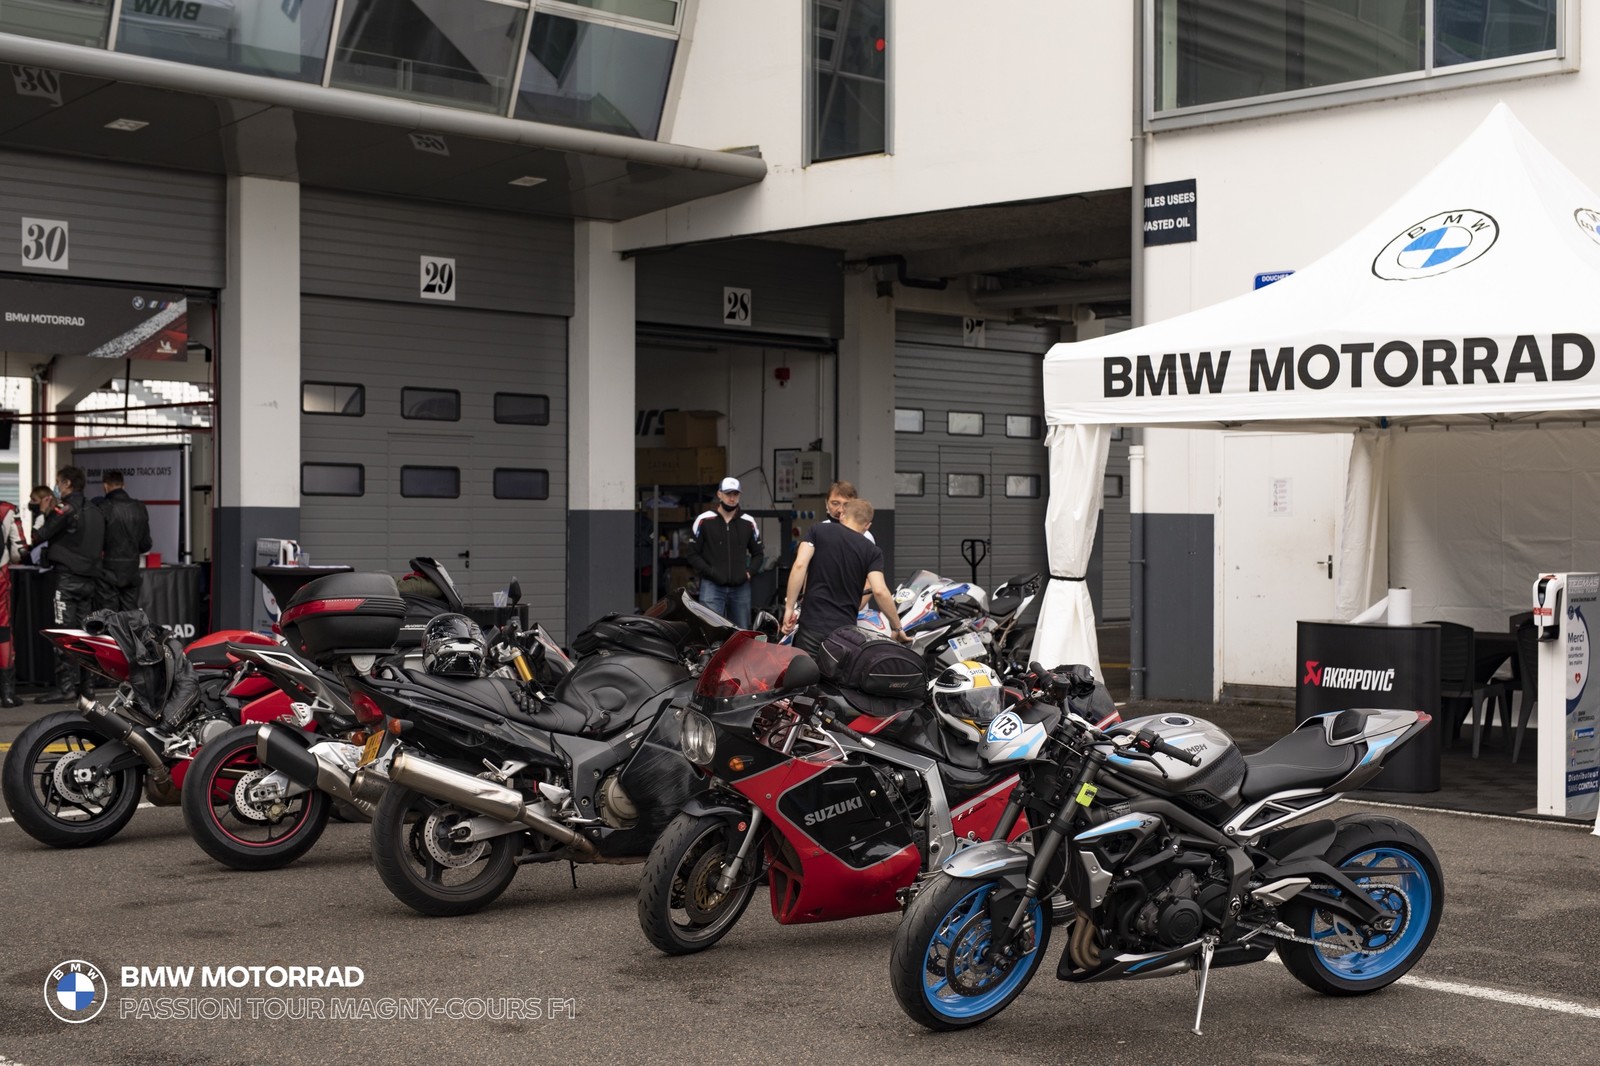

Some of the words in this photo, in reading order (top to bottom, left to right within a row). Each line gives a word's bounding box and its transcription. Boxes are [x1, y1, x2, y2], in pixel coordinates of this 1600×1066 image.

[1167, 192, 1195, 205] USEES
[1176, 217, 1190, 228] OIL
[1407, 213, 1491, 240] BMW
[23, 223, 67, 262] 30
[422, 261, 454, 294] 29
[725, 291, 750, 321] 28
[5, 311, 30, 322] BMW
[31, 314, 86, 326] MOTORRAD
[1103, 350, 1232, 398] BMW
[1249, 332, 1596, 393] MOTORRAD
[136, 467, 155, 476] TRACK
[156, 467, 172, 476] DAYS
[1568, 631, 1585, 643] Merci
[995, 716, 1018, 737] 173
[1578, 780, 1598, 791] CONTACT
[804, 796, 863, 826] SUZUKI
